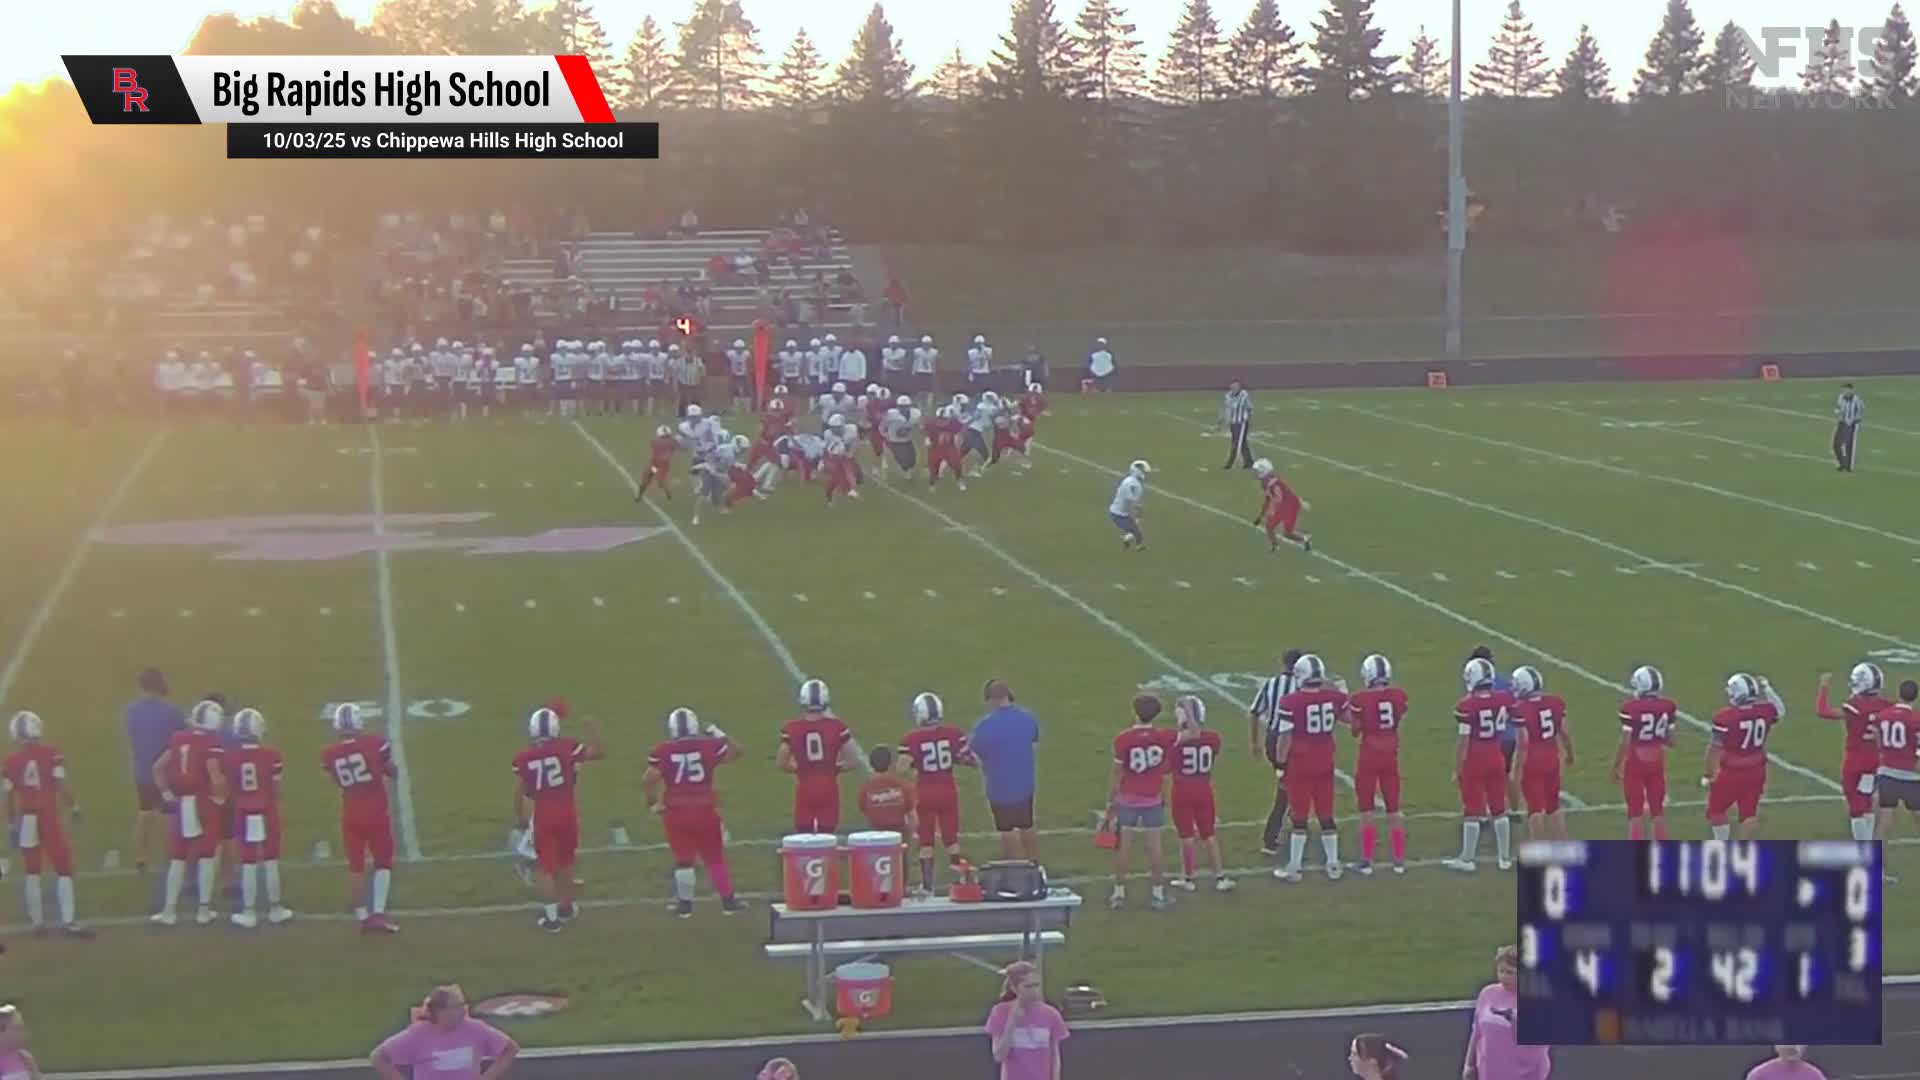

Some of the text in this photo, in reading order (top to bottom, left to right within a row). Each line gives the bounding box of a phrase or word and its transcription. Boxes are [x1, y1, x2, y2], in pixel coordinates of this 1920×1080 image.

[676, 318, 690, 335] 4
[1306, 702, 1335, 733] 66
[1378, 701, 1394, 729] 3
[1479, 706, 1508, 738] 54
[1539, 709, 1555, 740] 5
[1639, 712, 1669, 740] 24
[805, 732, 823, 761] 0
[1739, 718, 1767, 749] 70
[1880, 720, 1907, 748] 10
[180, 743, 191, 775] 1
[334, 752, 372, 787] 62
[671, 751, 705, 784] 75
[920, 739, 953, 772] 26
[1182, 746, 1212, 775] 30
[24, 760, 40, 787] 4
[241, 762, 258, 791] 8
[527, 755, 564, 790] 72
[806, 858, 824, 878] G
[874, 856, 892, 875] G
[1544, 866, 1567, 919] 0
[1845, 867, 1869, 921] 0
[1576, 951, 1599, 997] 4
[1652, 949, 1675, 1002] 2
[1711, 949, 1759, 1002] 42
[1799, 953, 1811, 998] 1
